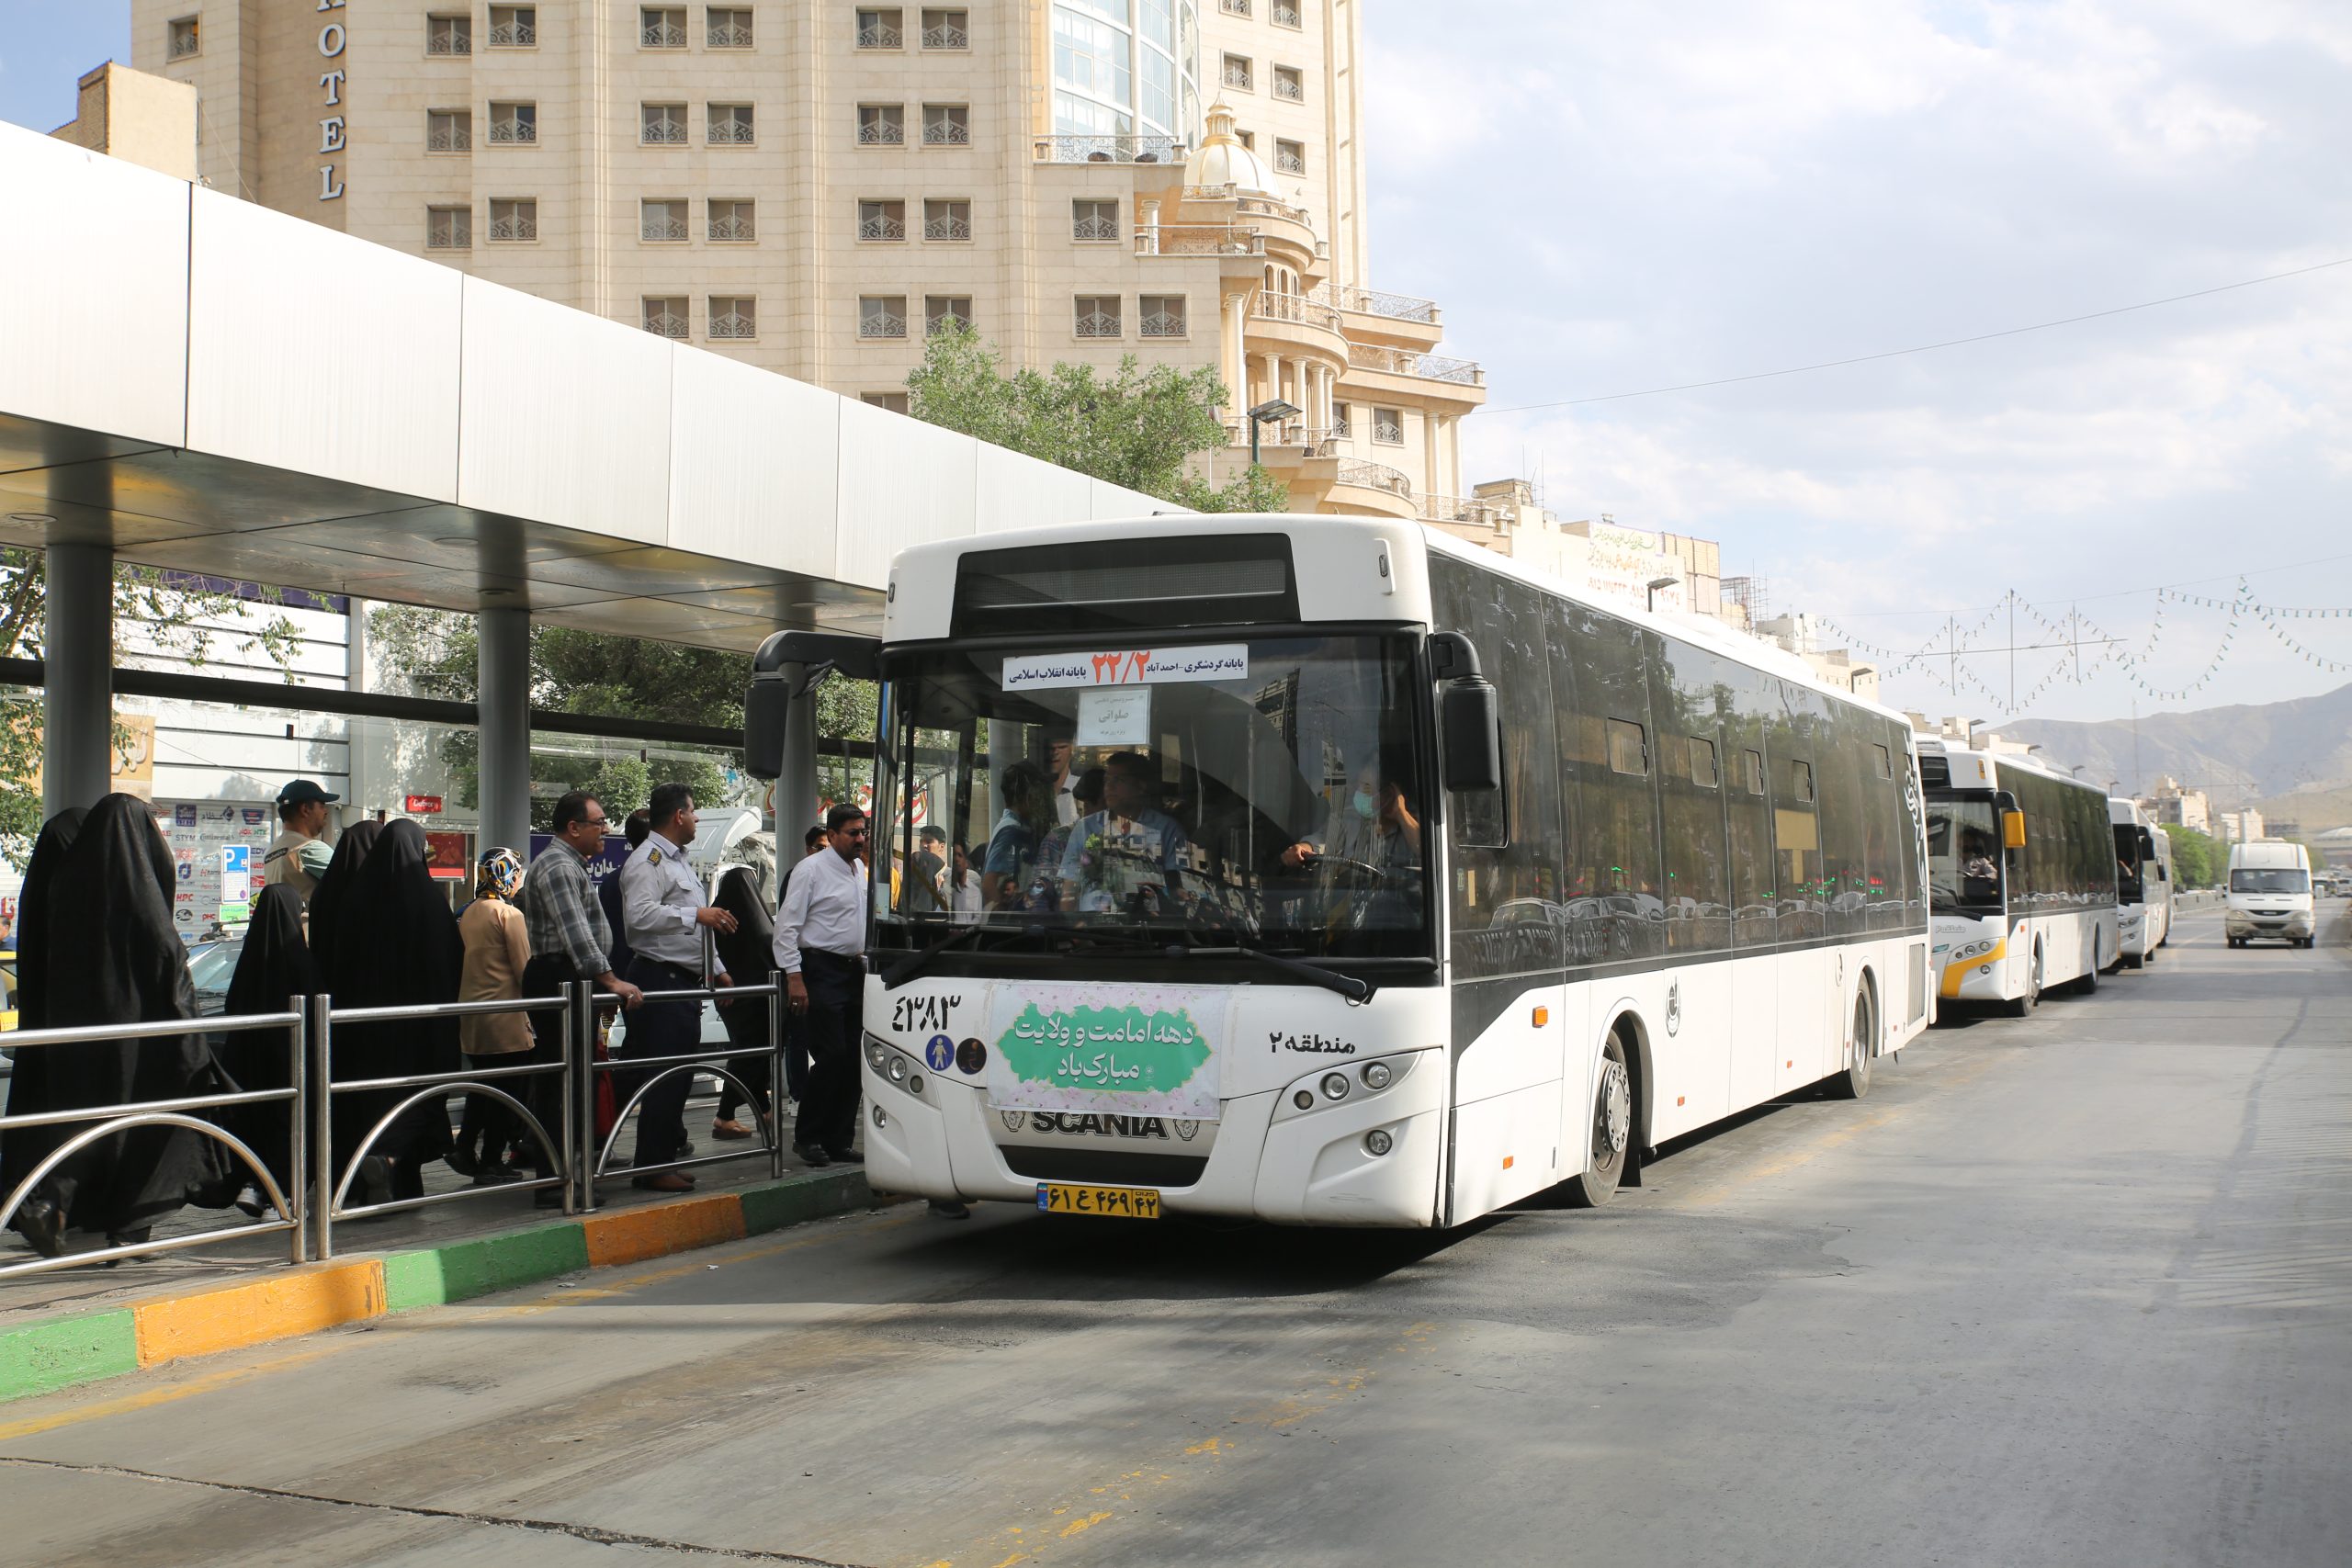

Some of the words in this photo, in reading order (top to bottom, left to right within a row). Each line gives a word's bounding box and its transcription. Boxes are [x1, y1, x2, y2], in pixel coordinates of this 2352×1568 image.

[1039, 667, 1065, 681] انقلاب
[1066, 666, 1086, 679] پایانه
[1184, 660, 1224, 673] گردشگری
[1224, 658, 1244, 671] پایانه
[1009, 669, 1039, 683] اسلامی
[1015, 1016, 1070, 1046] ولایت
[1073, 1027, 1085, 1047] و
[1088, 1018, 1152, 1043] امامت
[1153, 1024, 1193, 1044] دهه
[1269, 1032, 1283, 1053] ۲
[1285, 1034, 1355, 1054] منطقه
[1031, 1111, 1170, 1140] SCANIA
